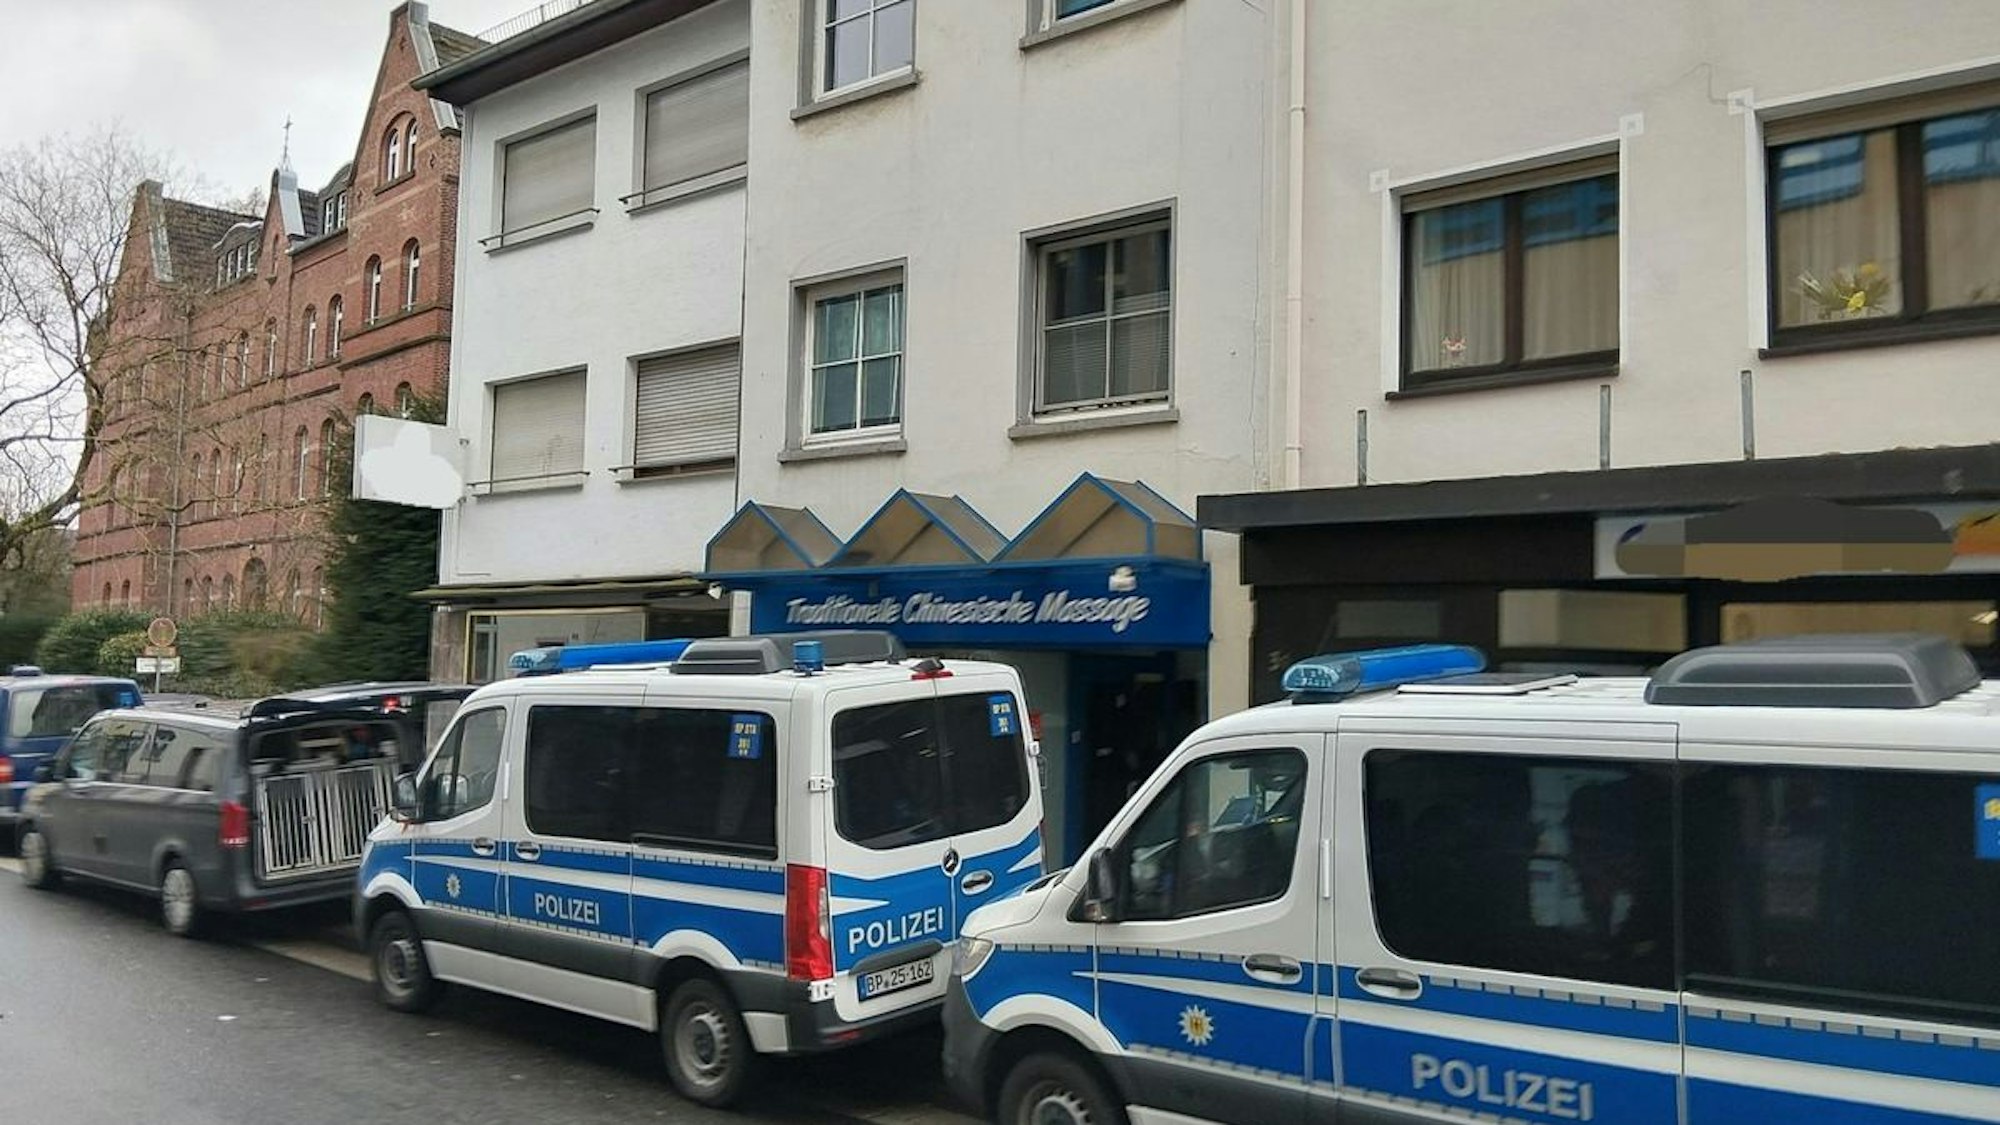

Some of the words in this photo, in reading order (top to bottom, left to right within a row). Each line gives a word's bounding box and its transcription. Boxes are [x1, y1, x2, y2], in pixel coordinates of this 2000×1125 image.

[786, 595, 903, 625] Traditionelle
[902, 590, 1037, 625] Chinesische
[1034, 589, 1151, 633] Massage
[534, 891, 600, 925] POLIZEI
[848, 906, 944, 954] POLIZEI
[865, 974, 883, 993] BP
[1411, 1052, 1595, 1122] POLIZEI
